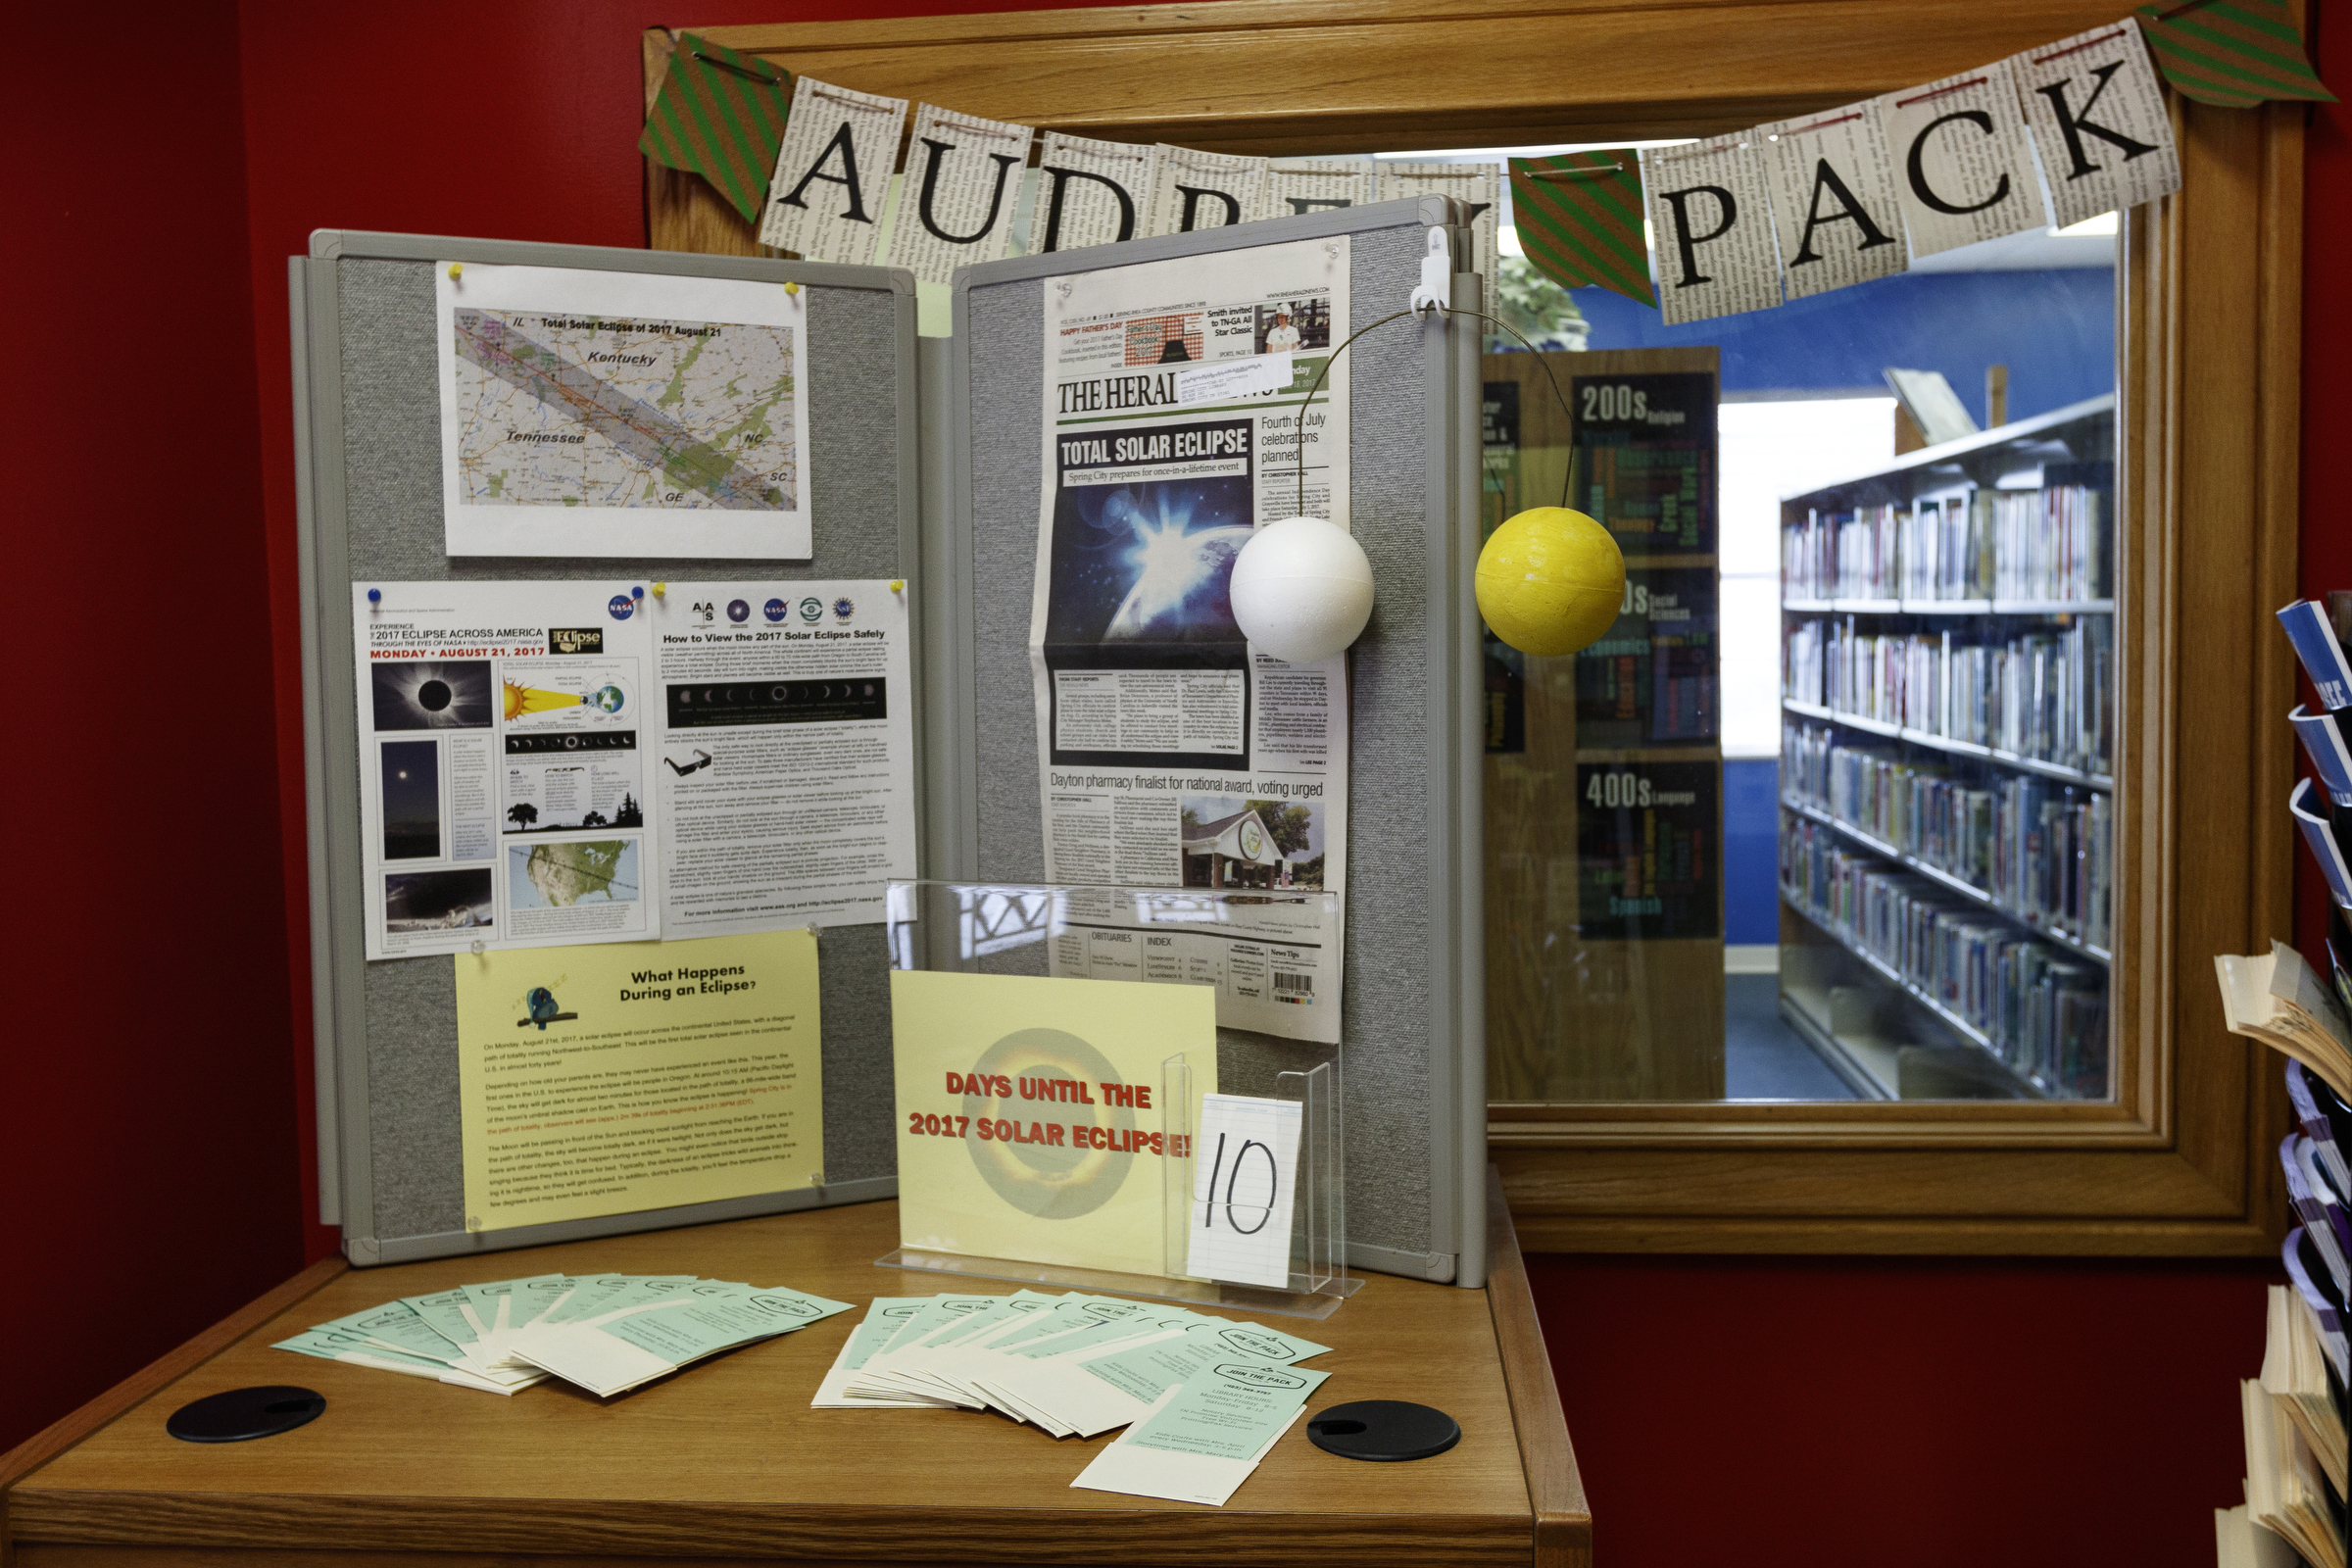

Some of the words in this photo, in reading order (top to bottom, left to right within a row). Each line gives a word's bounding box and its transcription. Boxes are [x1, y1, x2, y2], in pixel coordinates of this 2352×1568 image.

[1659, 60, 2161, 288] PACK
[1206, 308, 1228, 318] Smith
[1228, 305, 1252, 317] invited
[513, 317, 524, 327] IL
[540, 317, 566, 329] Total
[568, 318, 597, 330] Solar
[596, 320, 634, 333] Eclipse
[634, 322, 646, 333] of
[648, 323, 672, 337] 2017
[674, 325, 709, 338] August
[709, 326, 720, 337] 21
[1059, 326, 1081, 336] HAPPY
[1081, 322, 1109, 333] FATHER'S
[1109, 320, 1123, 330] DAY
[1150, 321, 1163, 333] Day
[1219, 317, 1242, 326] TN-GA
[1242, 315, 1252, 323] All
[1214, 328, 1229, 337] Star
[1229, 326, 1252, 335] Classic
[1129, 335, 1158, 346] Cookbook
[587, 350, 657, 368] Kentucky
[1135, 346, 1153, 357] 2017
[1058, 379, 1102, 413] THE
[1581, 383, 1647, 421] 200s
[1261, 416, 1292, 429] Fourth
[1305, 413, 1327, 428] July
[506, 429, 585, 444] Tennessee
[744, 432, 763, 445] NC
[1060, 439, 1111, 464] TOTAL
[1114, 434, 1170, 462] SOLAR
[1174, 427, 1248, 458] ECLIPSE
[1261, 448, 1299, 466] planned
[768, 471, 790, 481] SC
[1068, 468, 1093, 483] Spring
[1092, 467, 1108, 481] City
[1108, 469, 1141, 481] prepares
[1141, 466, 1152, 476] for
[1152, 463, 1217, 476] once-in-a-lifetime
[1216, 462, 1239, 471] event
[664, 491, 685, 502] GE
[375, 630, 400, 640] 2017
[401, 629, 446, 639] ECLIPSE
[448, 628, 494, 638] ACROSS
[495, 627, 543, 637] AMERICA
[662, 634, 688, 644] How
[690, 634, 703, 643] to
[704, 633, 732, 643] View
[734, 632, 753, 642] the
[755, 631, 781, 641] 2017
[784, 631, 811, 641] Solar
[813, 630, 851, 641] Eclipse
[853, 629, 885, 640] Safely
[369, 649, 426, 659] MONDAY
[438, 648, 488, 658] AUGUST
[491, 647, 511, 658] 21,
[514, 647, 544, 656] 2017
[1050, 771, 1084, 789] Dayton
[1085, 773, 1133, 792] pharmacy
[1134, 774, 1167, 790] finalist
[1167, 775, 1184, 790] for
[1186, 776, 1223, 791] national
[1223, 778, 1254, 794] award,
[1256, 779, 1289, 799] voting
[1291, 780, 1323, 799] urged
[1586, 771, 1652, 808] 400s
[808, 896, 883, 907] http://eclipse2017.nasa.gov
[1091, 930, 1132, 943] OBITUARIES
[1147, 936, 1172, 947] INDEX
[1270, 948, 1287, 956] News
[1286, 950, 1299, 959] Tips
[630, 969, 673, 984] What
[677, 965, 745, 982] Happens
[619, 986, 671, 1002] During
[675, 985, 695, 996] an
[700, 979, 756, 996] Eclipse?
[521, 1038, 544, 1048] August
[561, 1034, 578, 1043] 2017,
[632, 1028, 653, 1037] occur
[946, 1071, 1012, 1099] DAYS
[1018, 1076, 1095, 1104] UNTIL
[1099, 1082, 1152, 1109] THE
[908, 1111, 970, 1139] 2017
[976, 1116, 1065, 1147] SOLAR
[1071, 1124, 1191, 1157] ECLIPSE!
[1204, 1132, 1277, 1235] 10
[1230, 1333, 1248, 1343] JOIN
[1261, 1344, 1281, 1355] PACK
[1249, 1372, 1265, 1381] THE
[1267, 1376, 1293, 1386] PACK
[1200, 1392, 1259, 1407] Monday-Friday
[1211, 1389, 1244, 1398] LIBRARY
[1204, 1398, 1241, 1409] Saturday
